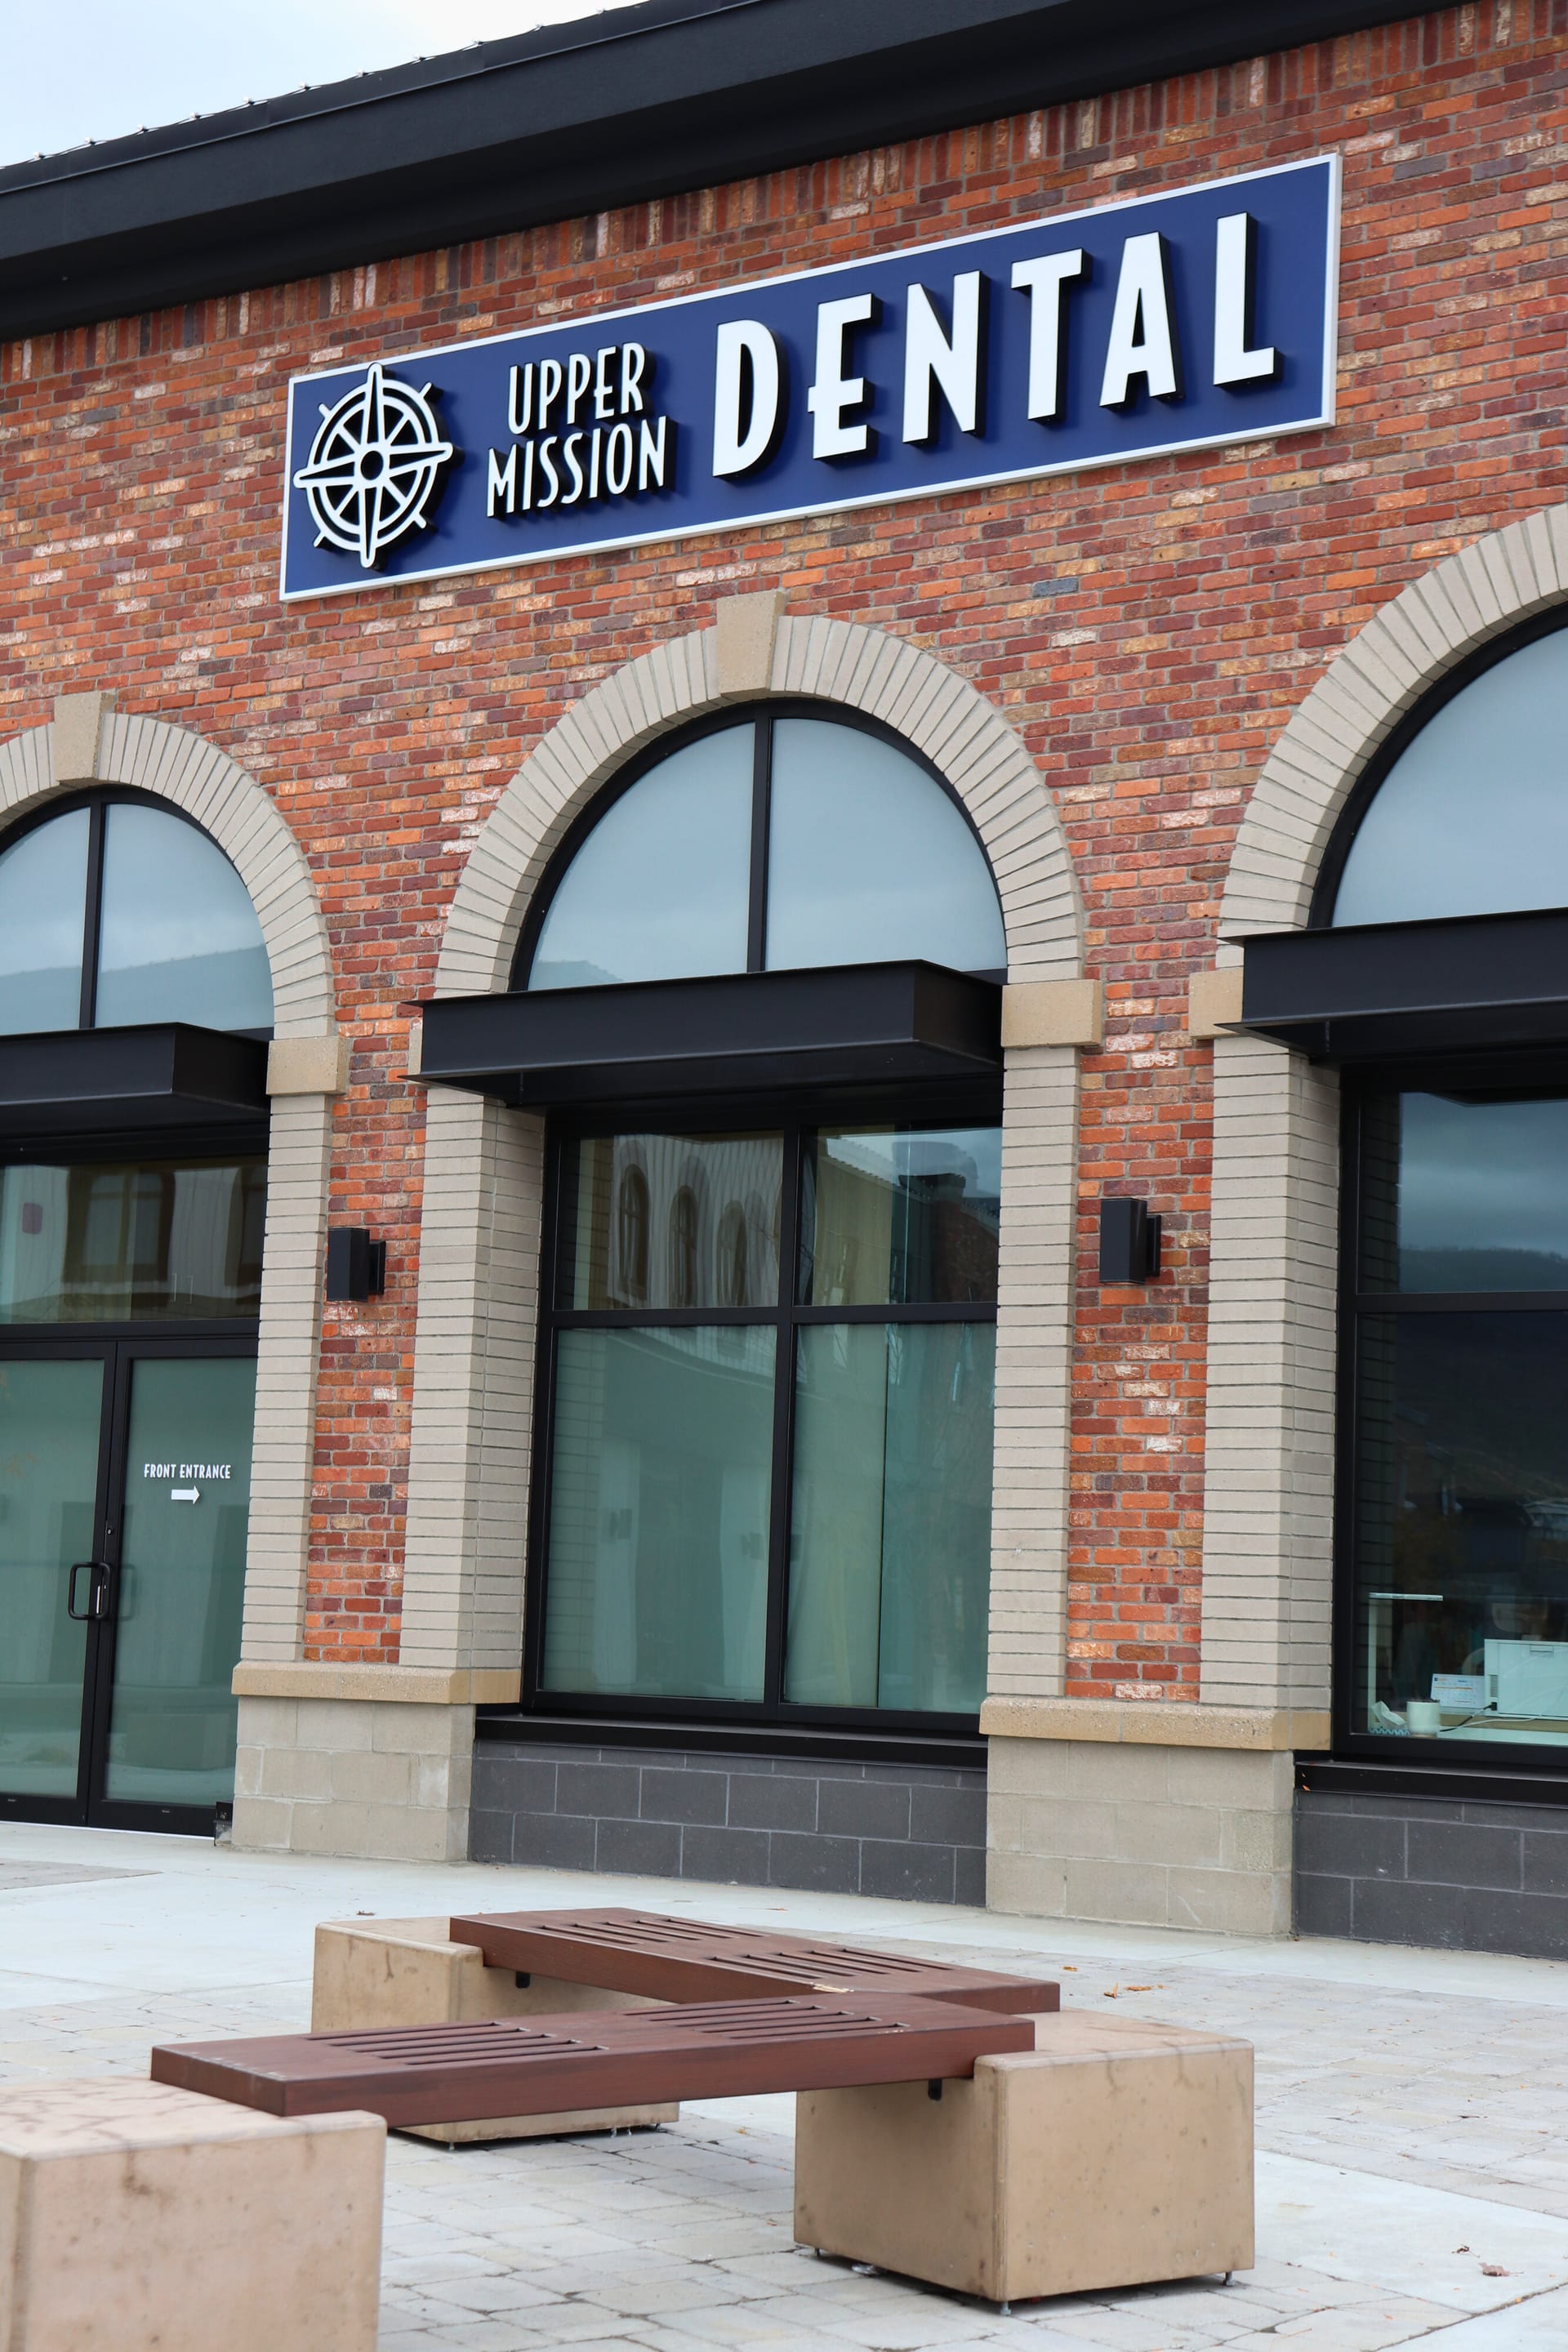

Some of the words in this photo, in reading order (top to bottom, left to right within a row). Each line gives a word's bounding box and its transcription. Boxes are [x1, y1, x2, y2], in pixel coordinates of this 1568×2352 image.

[507, 341, 646, 435] UPPER
[712, 212, 1275, 477] DENTAL
[487, 415, 667, 518] MISSION
[144, 1463, 176, 1478] FRONT
[180, 1463, 231, 1479] ENTRANCE
